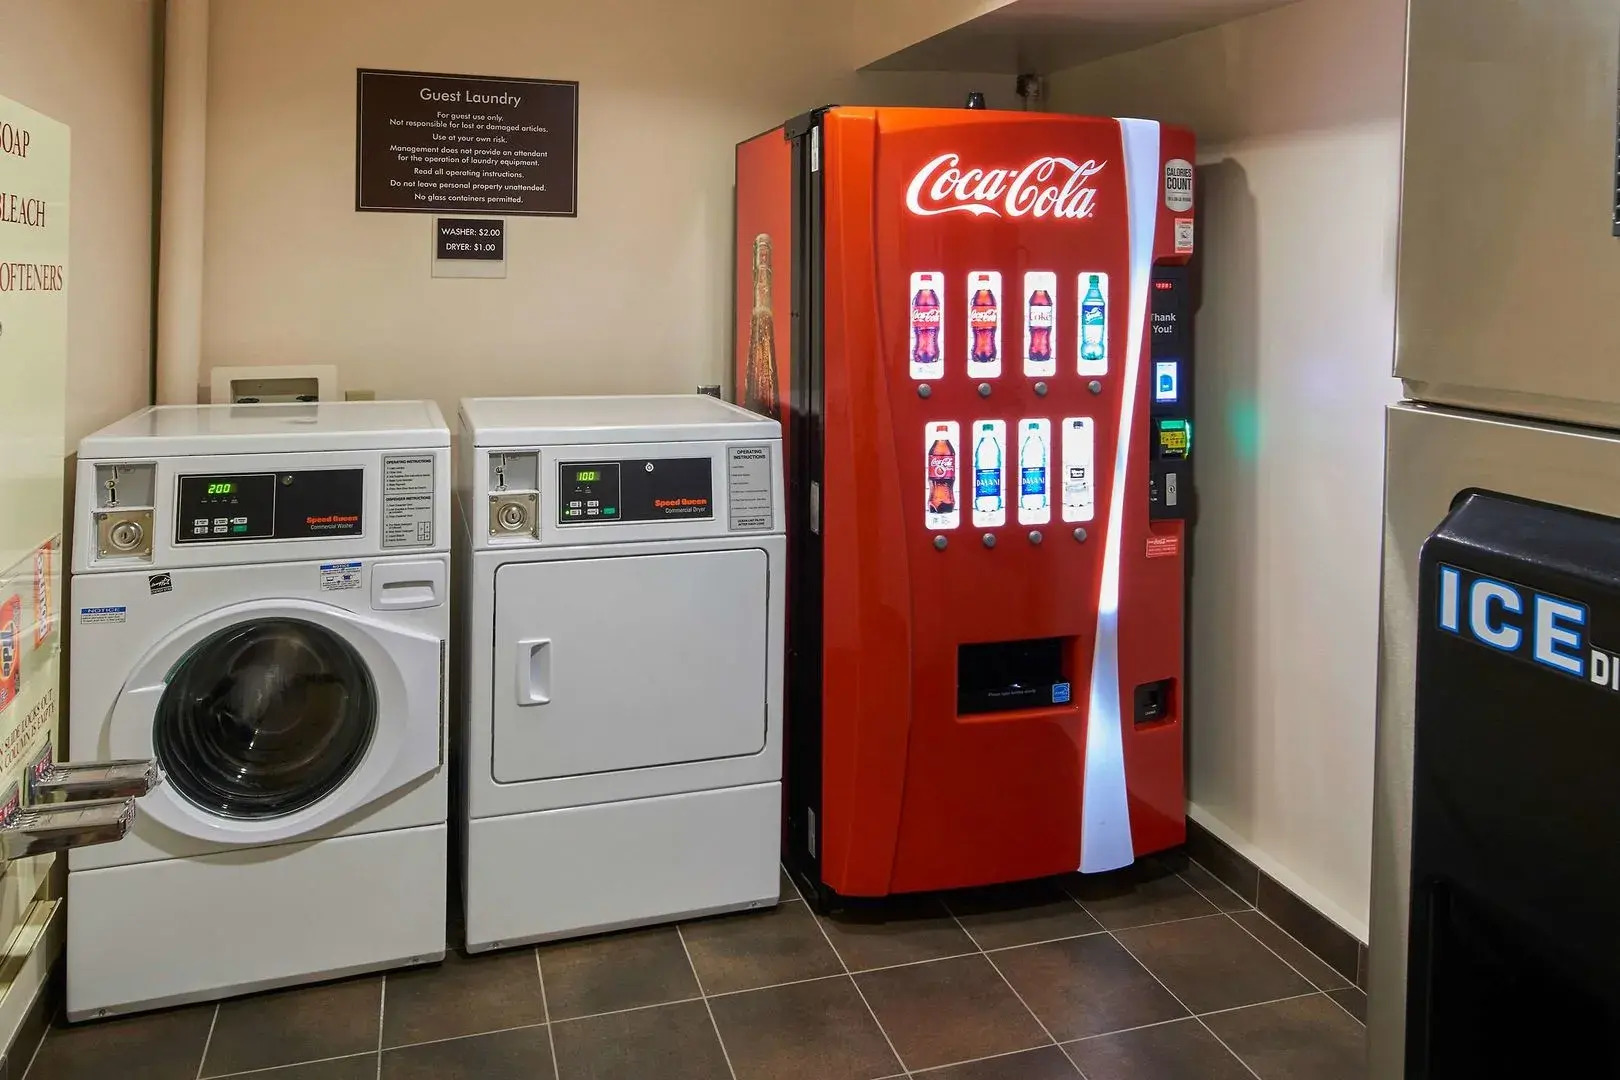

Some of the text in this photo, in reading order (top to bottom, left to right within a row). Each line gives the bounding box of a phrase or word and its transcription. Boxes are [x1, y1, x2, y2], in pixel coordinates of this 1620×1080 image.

[420, 88, 521, 108] Guest Laundry
[451, 113, 470, 121] guest
[406, 120, 447, 128] responsible
[486, 123, 520, 132] damaged
[0, 122, 30, 158] OAP
[390, 145, 439, 154] Management
[474, 148, 501, 156] provide
[424, 155, 460, 164] operation
[471, 157, 498, 166] laundry
[500, 158, 540, 167] equipment.
[446, 169, 480, 178] operating
[482, 170, 524, 178] instructions.
[1167, 168, 1191, 177] CALORIES
[439, 182, 470, 190] personal
[472, 182, 503, 191] property
[906, 154, 1107, 218] Coca-Cola
[1167, 178, 1191, 190] COUNT
[428, 194, 446, 202] glass
[487, 196, 523, 204] permitted.
[441, 228, 500, 237] WASHER: $2.00
[446, 243, 496, 252] DRYER: $1.00
[1151, 313, 1176, 322] Thank
[1153, 325, 1172, 333] You!
[579, 472, 595, 481] 100
[208, 484, 231, 494] 200
[655, 499, 680, 507] Speed
[306, 515, 358, 524] Speed Queen
[1440, 566, 1586, 676] ICE
